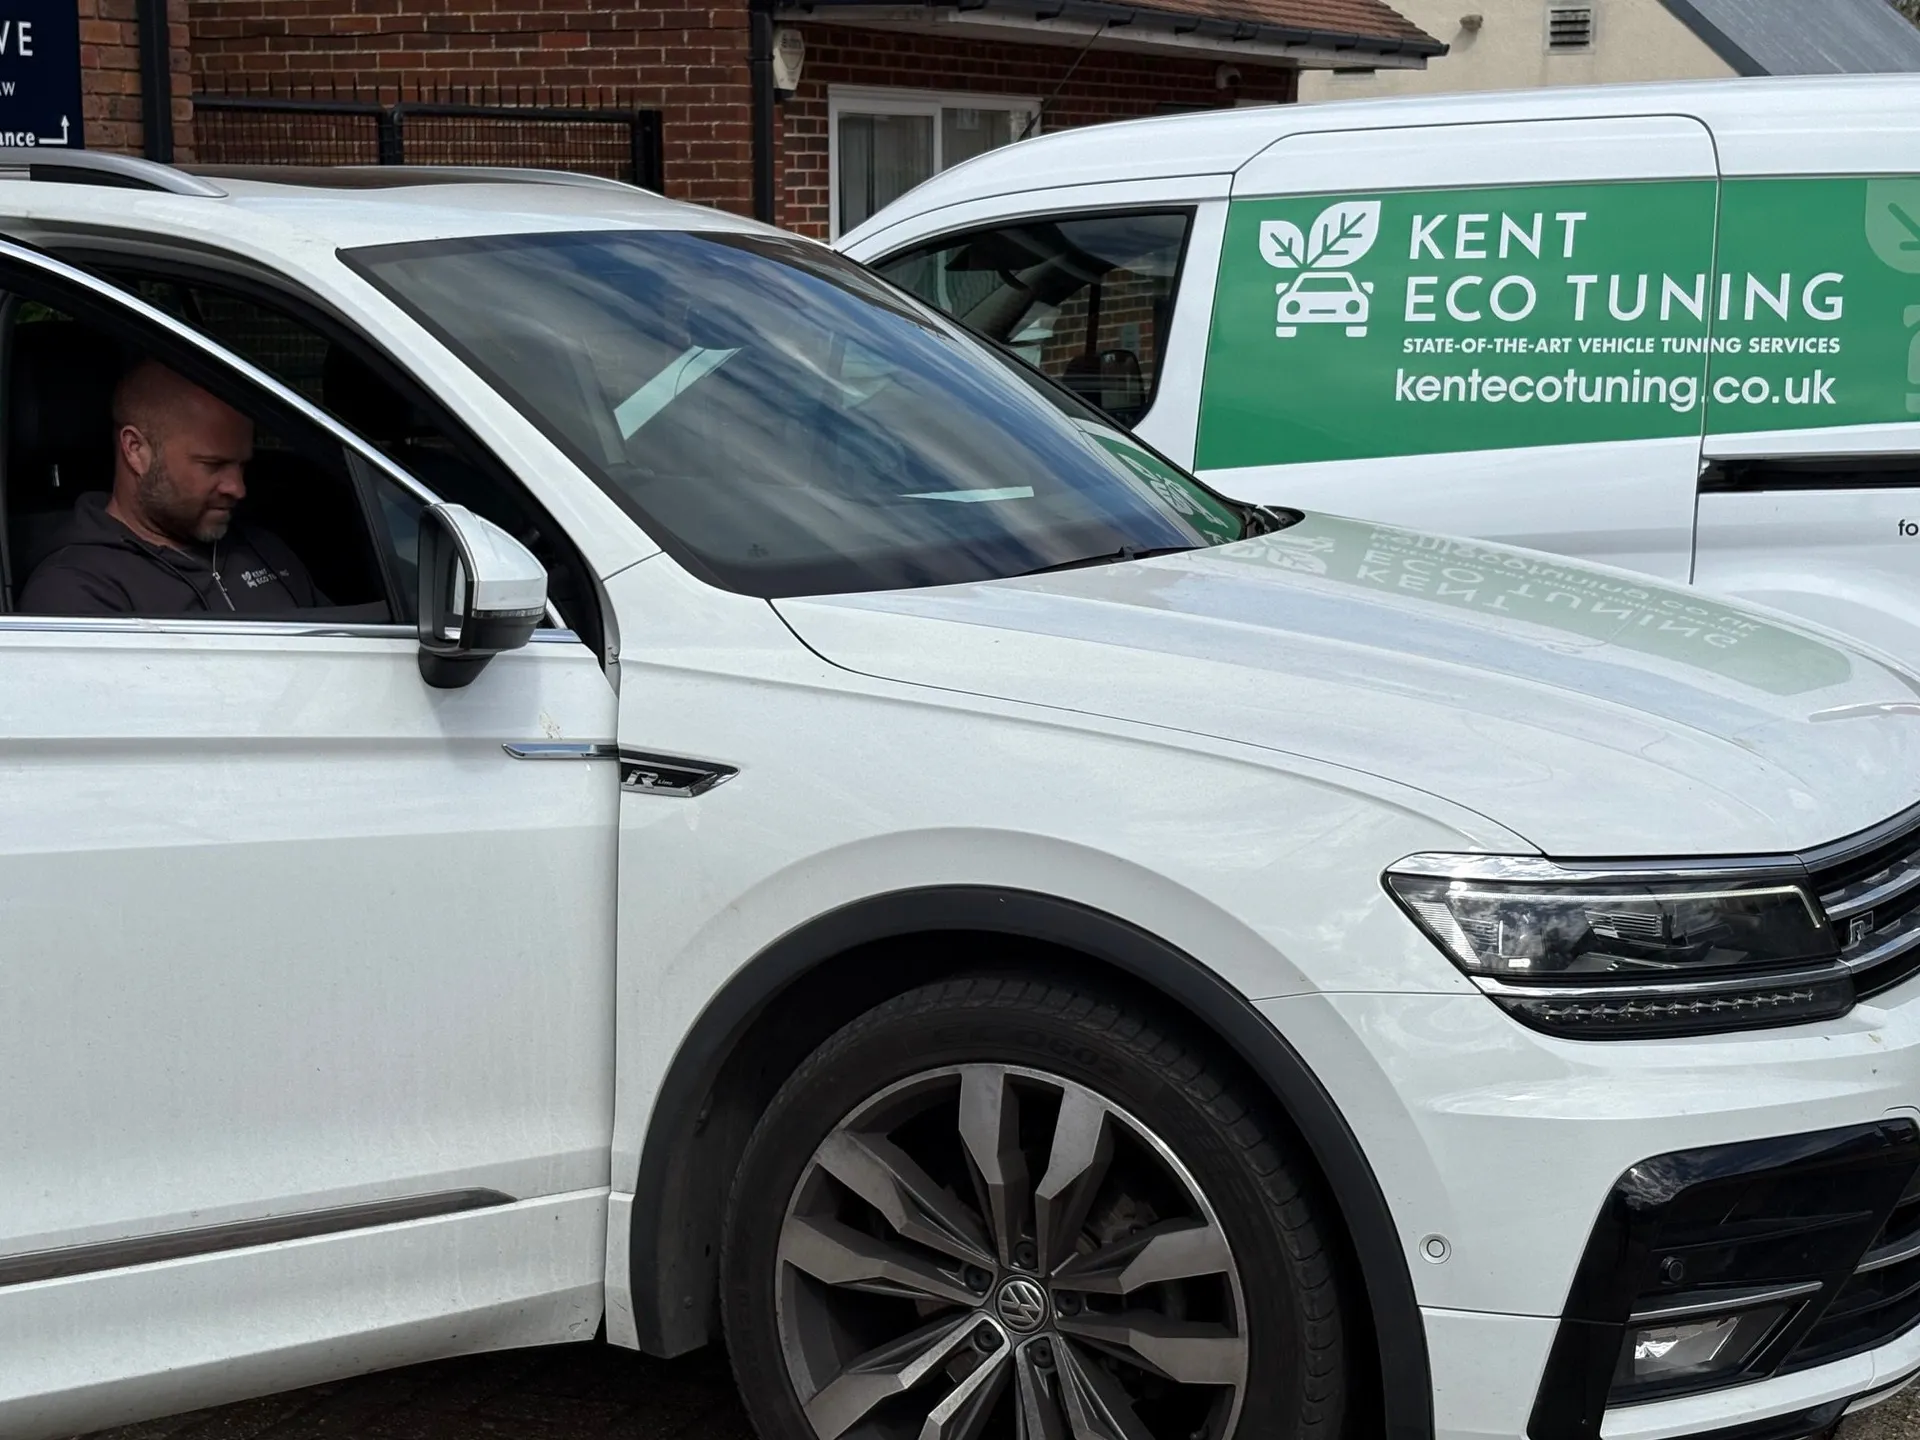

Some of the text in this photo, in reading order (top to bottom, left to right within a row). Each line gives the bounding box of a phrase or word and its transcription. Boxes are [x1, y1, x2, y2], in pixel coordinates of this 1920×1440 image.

[0, 81, 16, 96] W
[1409, 211, 1587, 260] KENT
[1404, 272, 1844, 322] ECO TUNING
[1403, 337, 1841, 354] STATE-OF-THE-ART VEHICLE TUNING SERVICES
[1395, 368, 1837, 413] kentecotuning.co.uk
